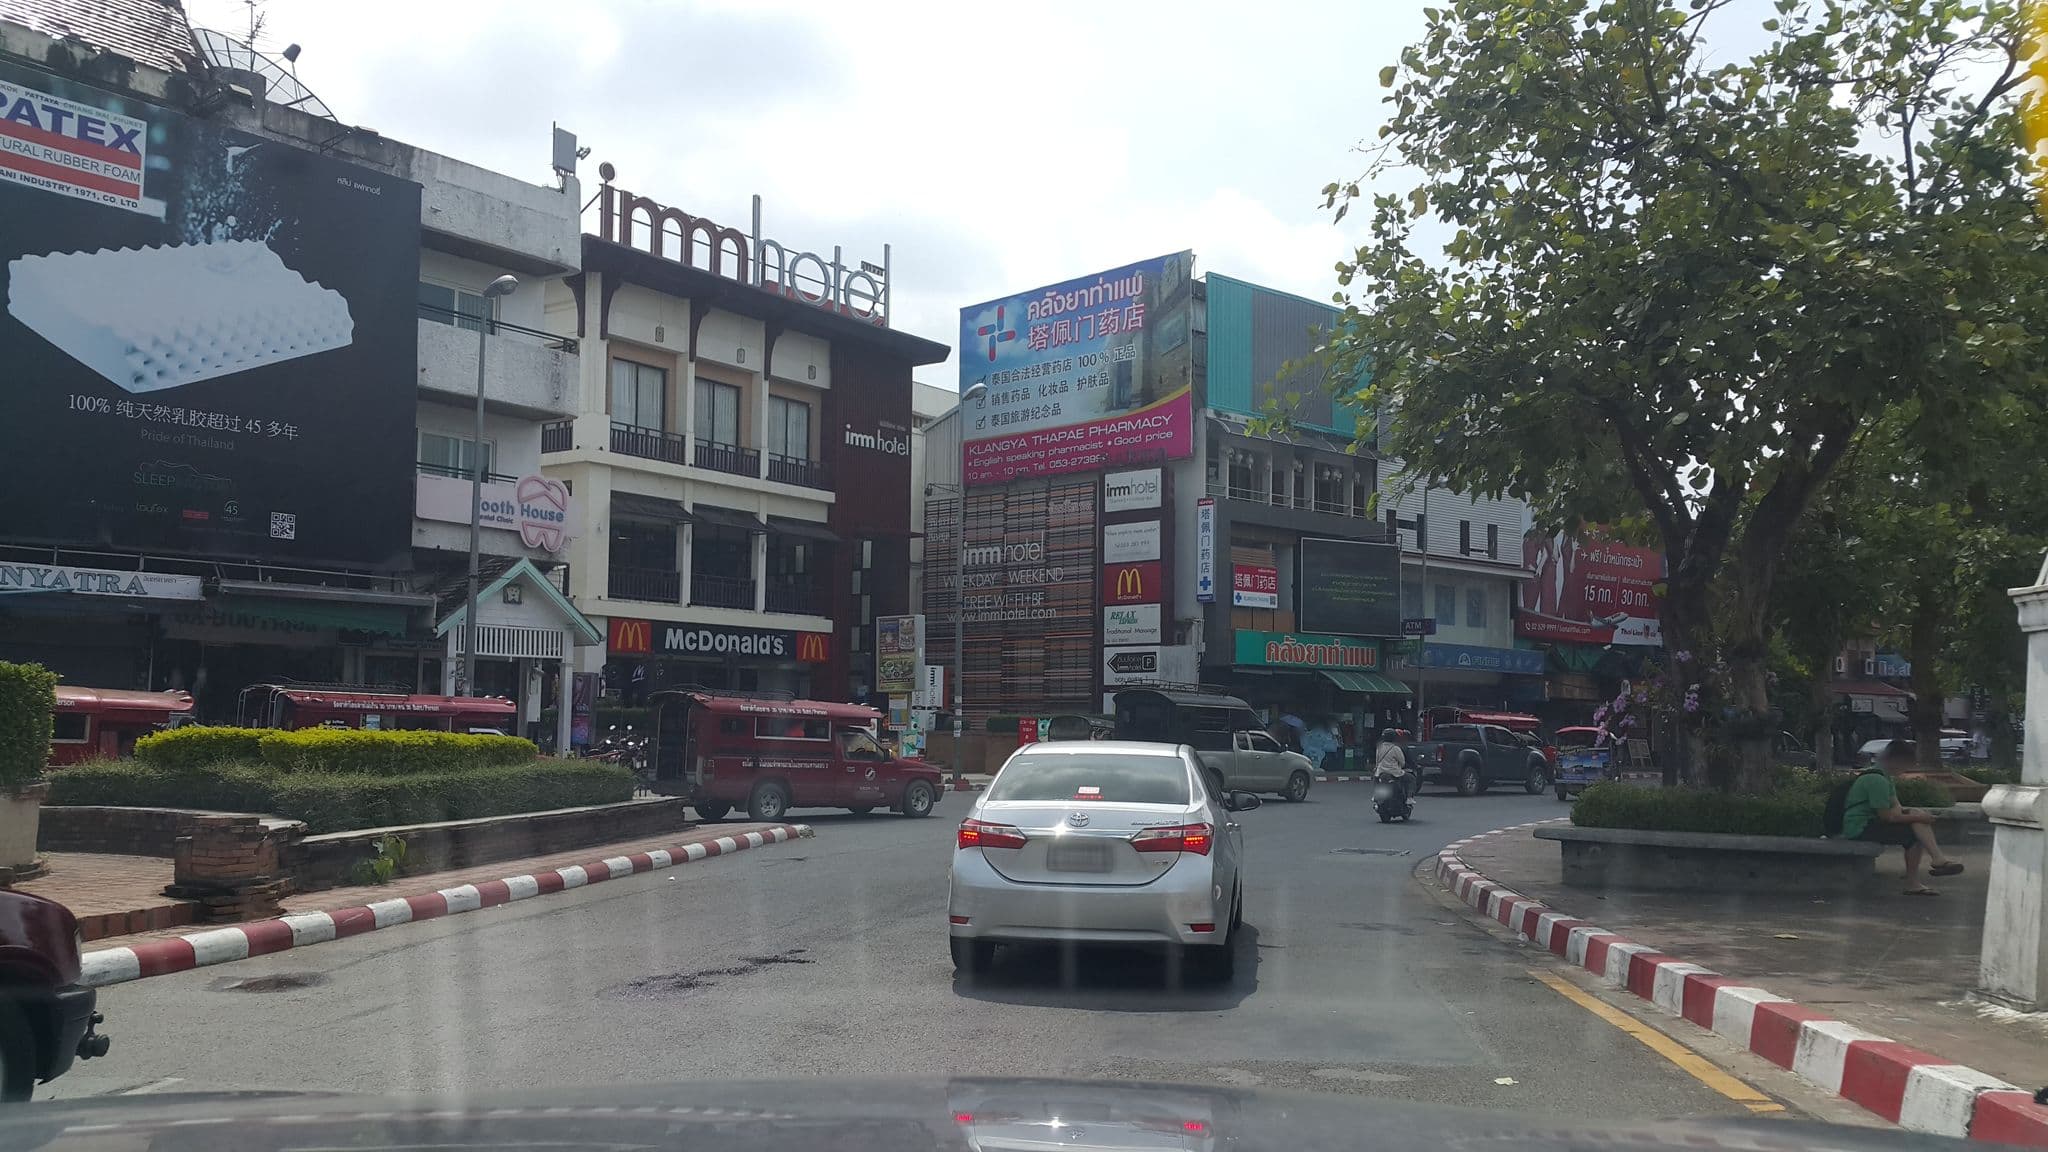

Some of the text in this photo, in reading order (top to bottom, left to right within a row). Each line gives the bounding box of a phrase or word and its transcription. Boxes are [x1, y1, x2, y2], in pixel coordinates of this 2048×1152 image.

[25, 91, 59, 106] PATTAYA
[113, 115, 143, 128] PHUKET
[0, 136, 141, 183] URAL RUBBER FOAM
[19, 172, 71, 192] INDUSTRY
[1028, 303, 1145, 351] 塔佩门药店
[68, 393, 299, 441] 100% 纯天然乳胶超过 45 多年
[140, 428, 235, 450] Pride of Thailand
[969, 413, 1173, 455] KLANGYA THAPAE PHARMACY
[973, 430, 1173, 467] English speaking pharmacist Good price
[133, 471, 176, 487] SLEEP
[968, 471, 978, 480] 10
[1003, 466, 1014, 476] 10
[480, 500, 564, 522] ooth House
[943, 567, 1064, 588] WEKDAY WEEKEND
[962, 595, 992, 609] FREE
[1584, 584, 1596, 601] 15
[1621, 588, 1633, 606] 30
[1405, 621, 1422, 630] ATM
[664, 628, 785, 656] McDonald's
